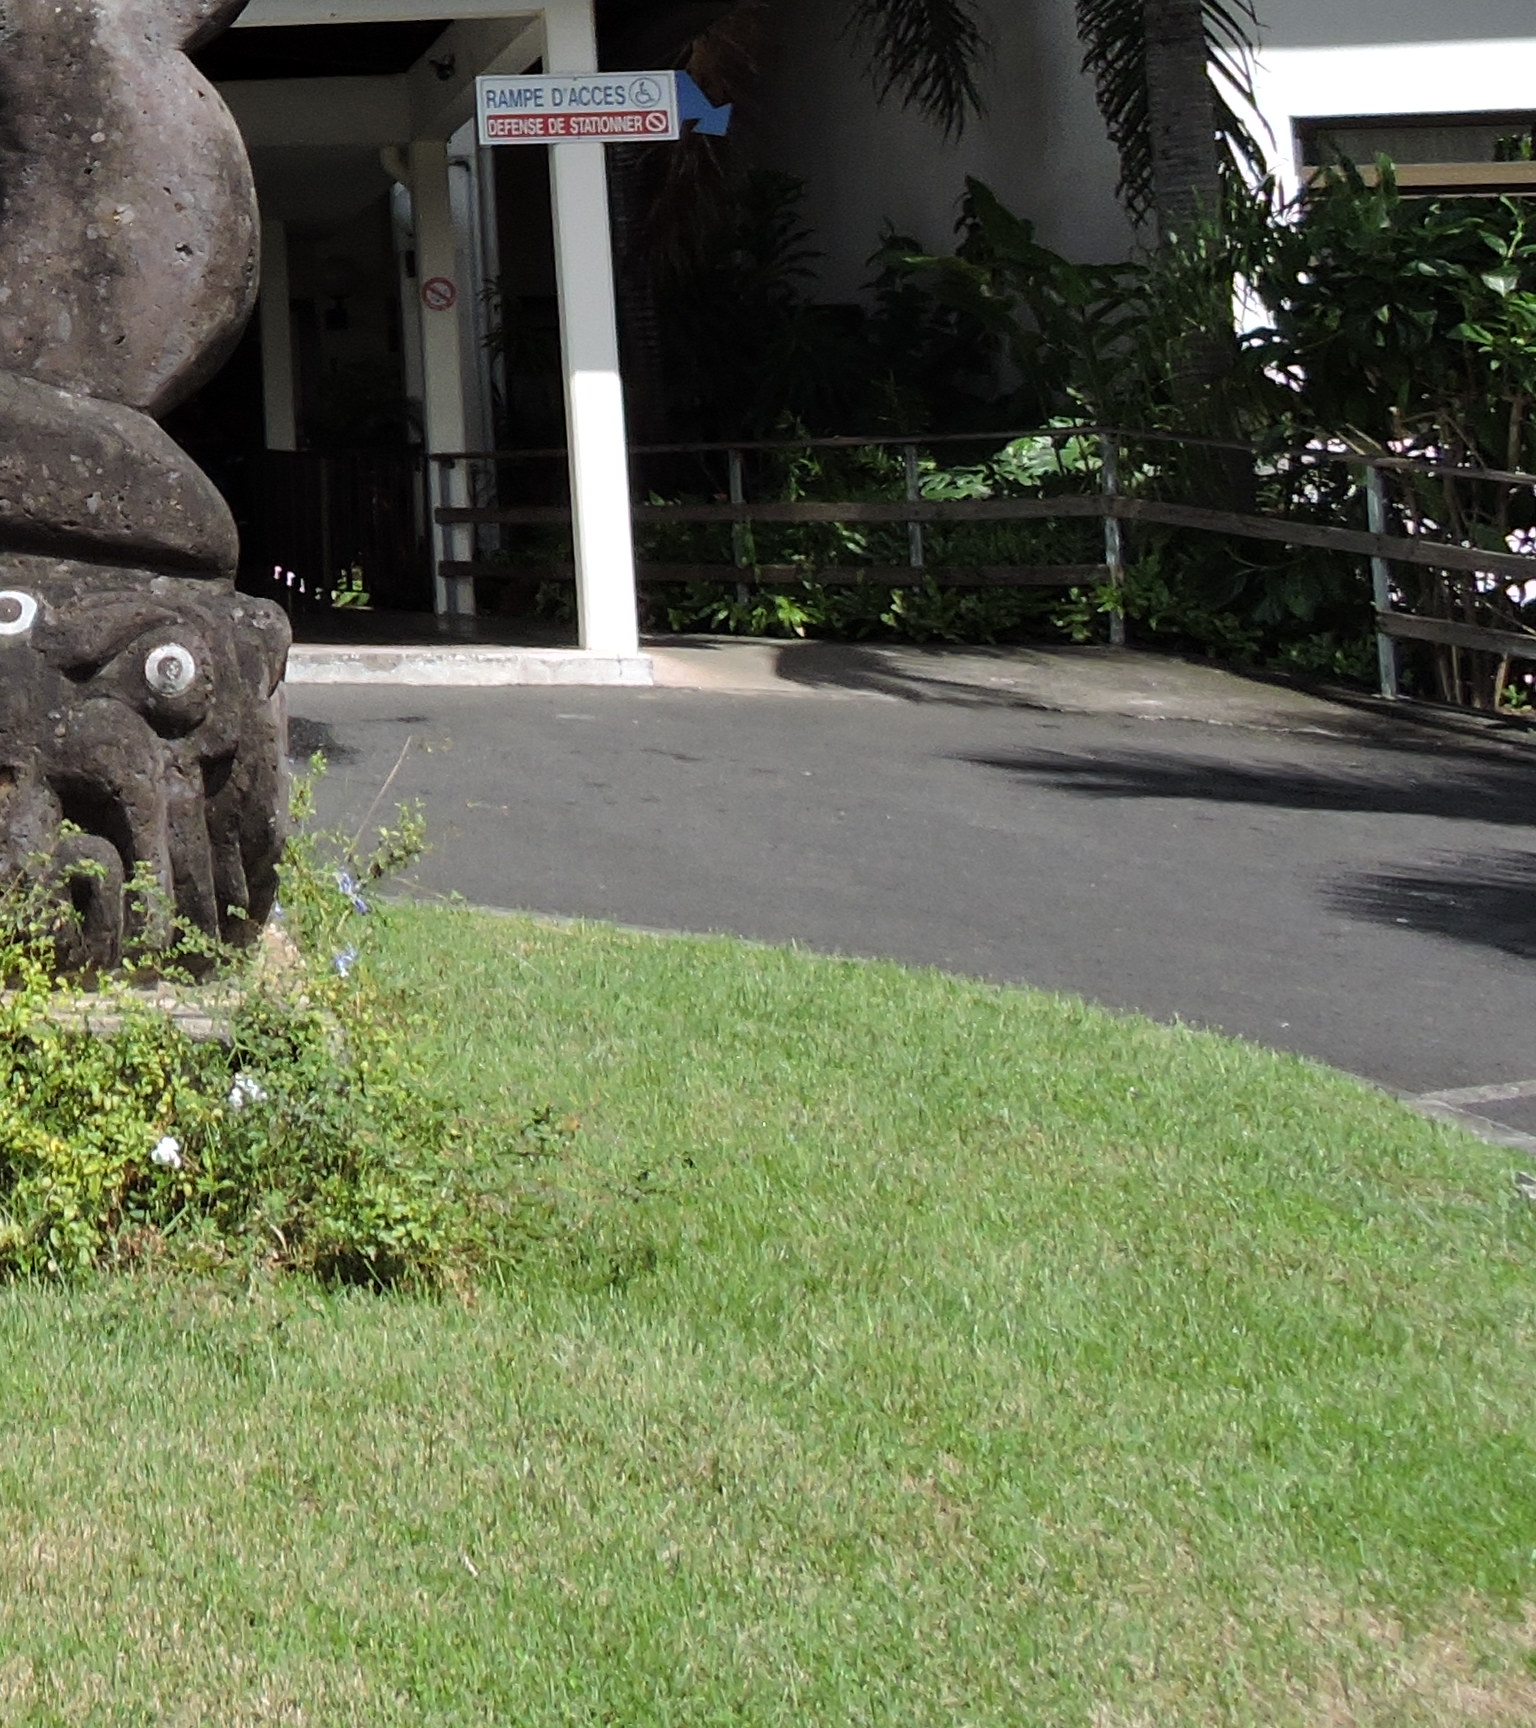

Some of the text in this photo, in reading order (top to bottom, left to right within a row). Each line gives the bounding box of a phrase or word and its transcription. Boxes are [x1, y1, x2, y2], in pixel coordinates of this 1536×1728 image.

[486, 85, 626, 108] RAMPE D'ACCES
[488, 115, 643, 135] DEFENSE DE STATIONNER
